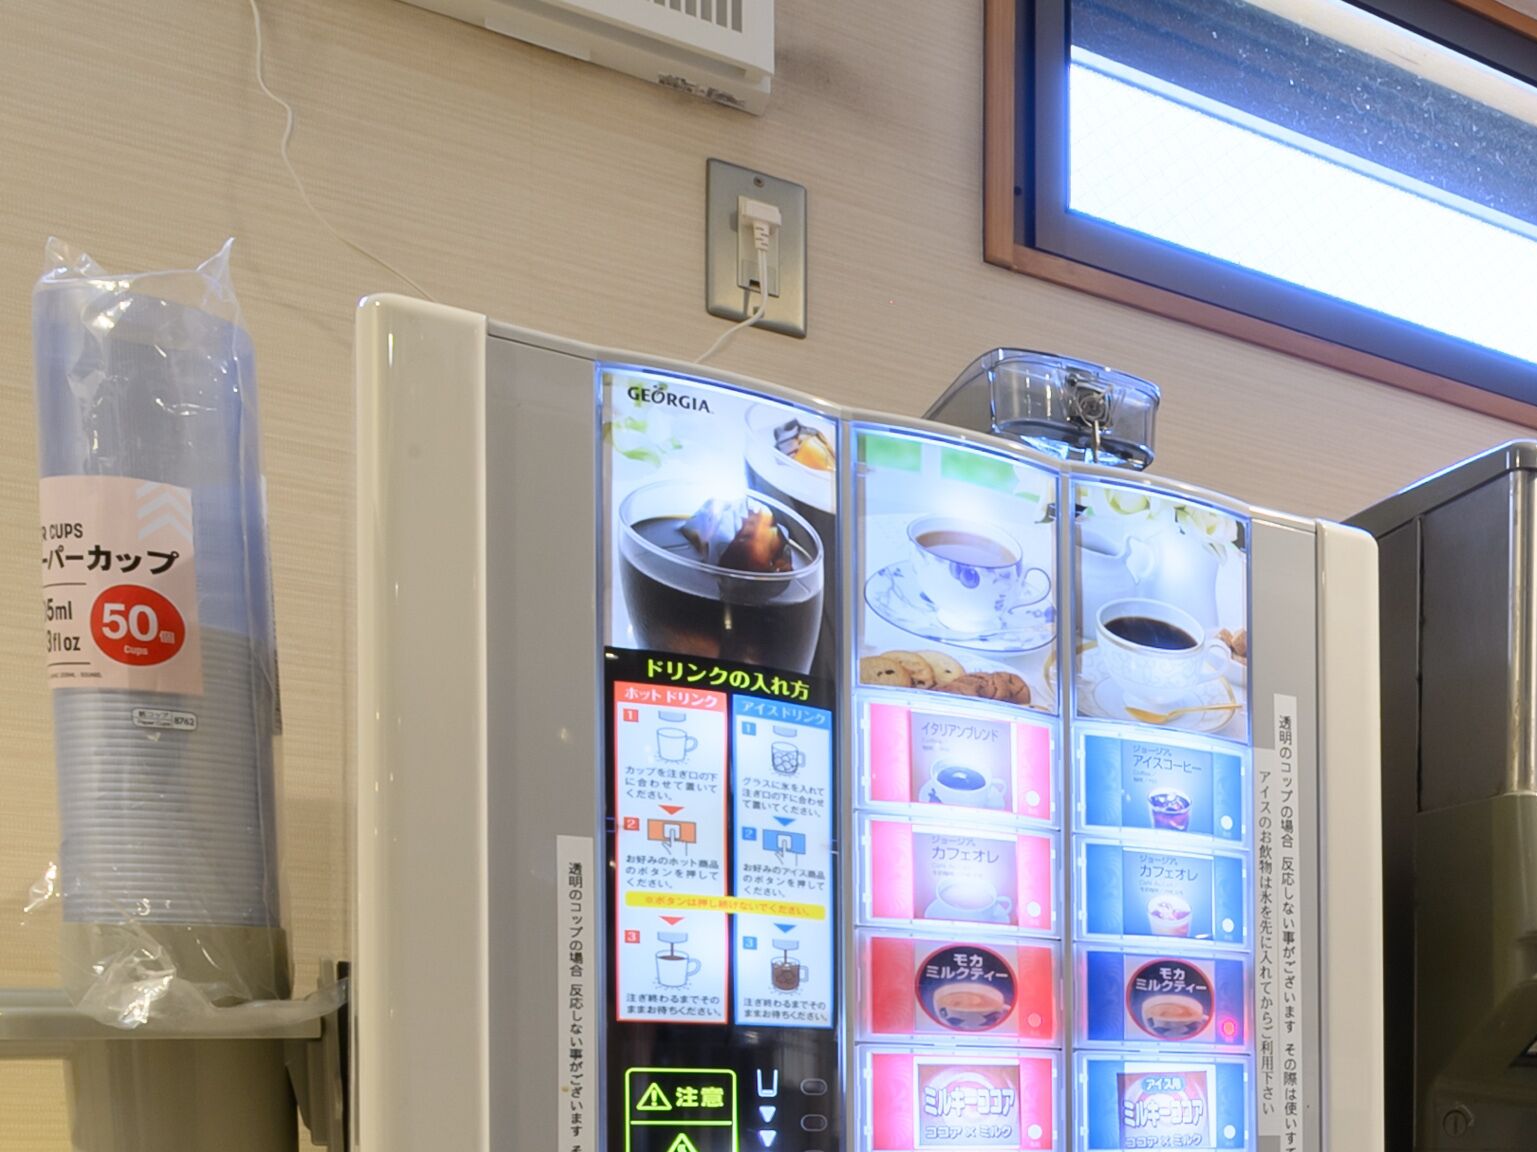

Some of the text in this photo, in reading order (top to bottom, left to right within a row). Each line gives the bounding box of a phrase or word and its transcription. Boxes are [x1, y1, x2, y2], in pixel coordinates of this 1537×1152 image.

[627, 384, 711, 414] GEORGIA
[50, 523, 83, 539] CUPS
[647, 658, 810, 701] ドリンクの入れ方
[1133, 754, 1202, 774] アイスコーヒー
[931, 846, 999, 864] カフェオレ
[1139, 864, 1199, 881] カフェオレ
[953, 953, 984, 967] モカ
[925, 964, 1009, 982] ミルクティー
[1160, 967, 1186, 980] モカ
[1135, 978, 1208, 993] ミルクティー
[675, 1086, 725, 1108] 注意
